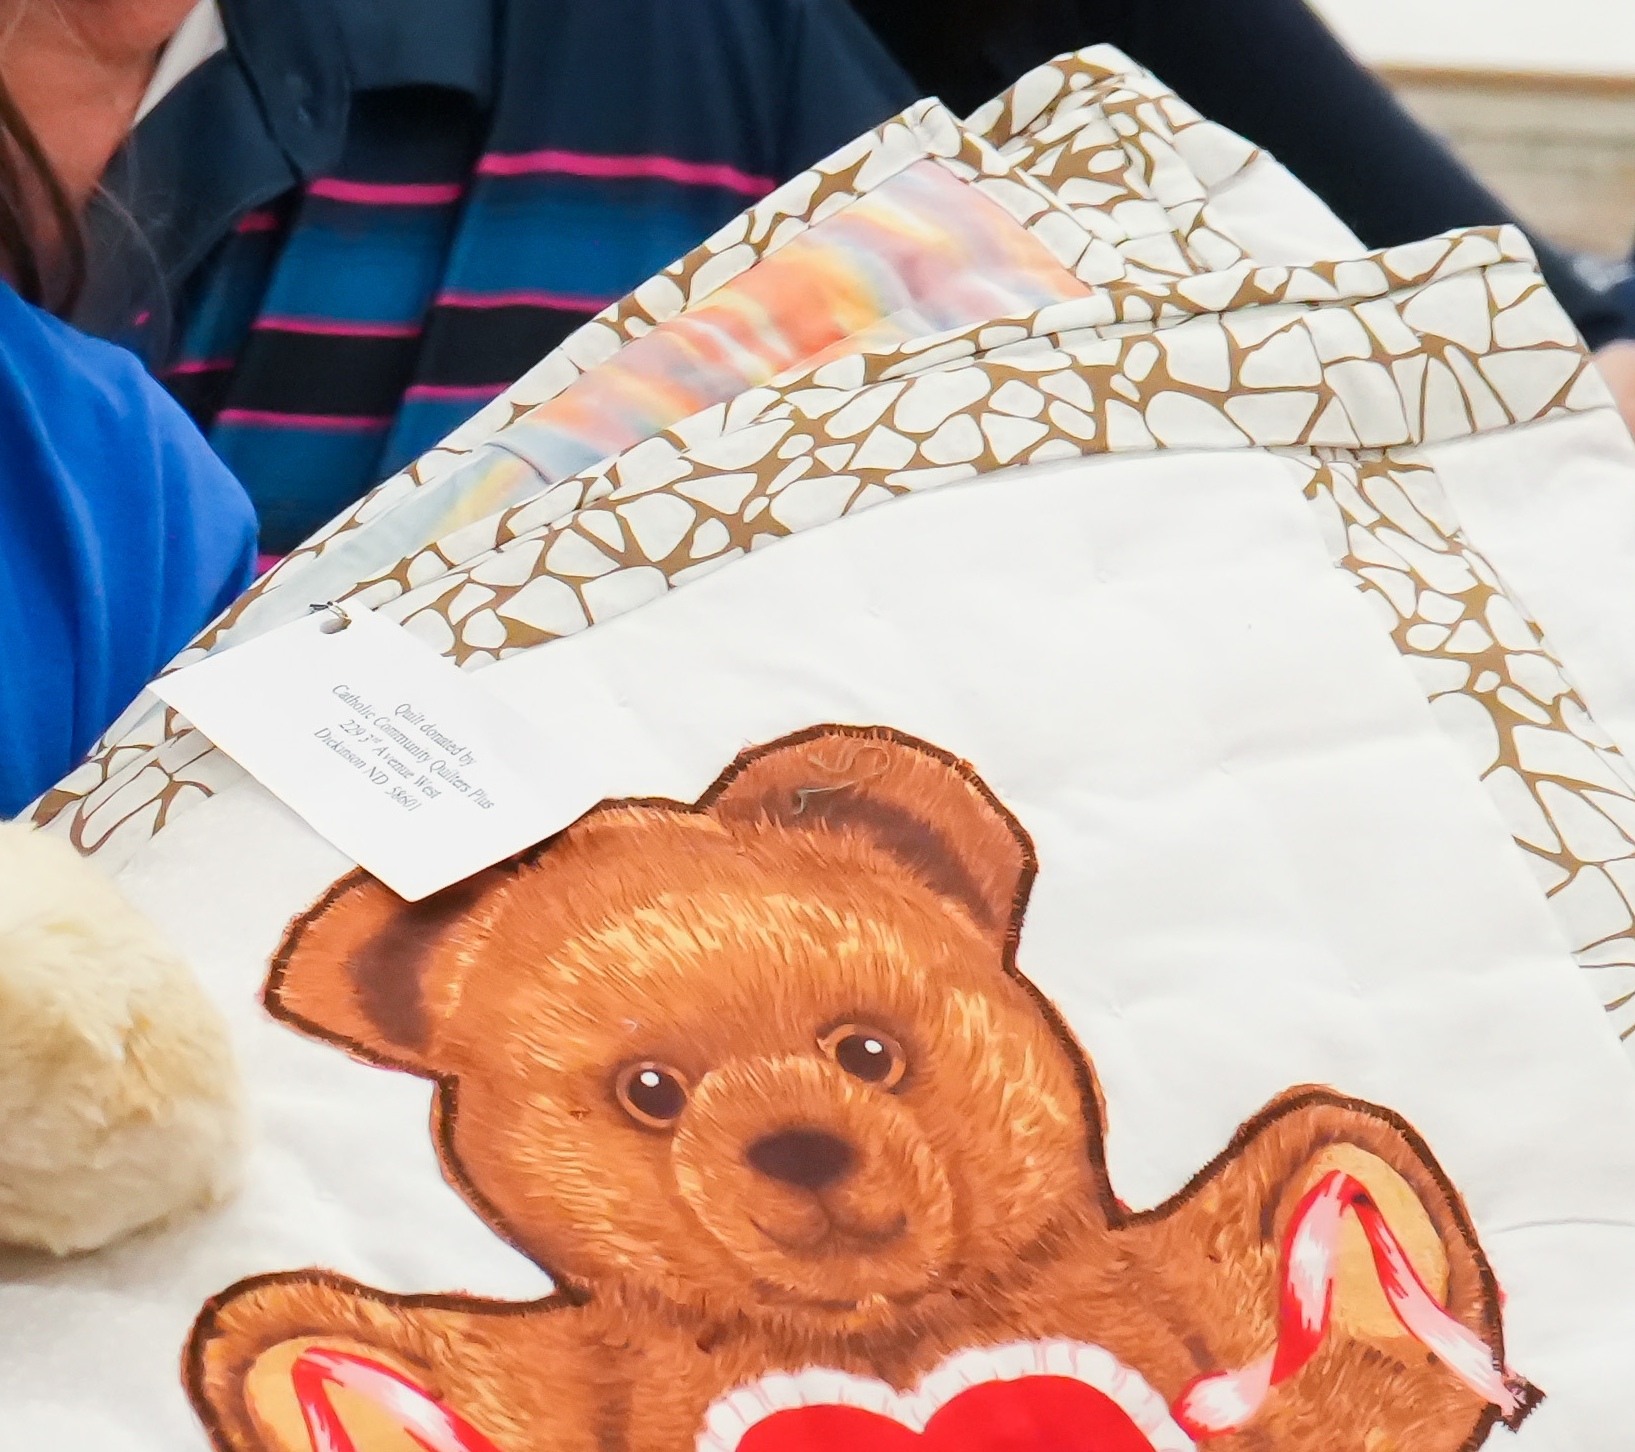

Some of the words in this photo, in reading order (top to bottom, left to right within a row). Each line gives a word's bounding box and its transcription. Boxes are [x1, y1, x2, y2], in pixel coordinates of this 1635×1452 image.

[314, 727, 367, 770] Dickinson
[363, 766, 389, 786] ND
[384, 786, 422, 812] 58601
[332, 684, 376, 720] Catholic
[373, 716, 433, 764] Community
[429, 759, 472, 793] Quilters
[467, 788, 495, 810] Plus
[339, 719, 366, 737] 229
[372, 746, 415, 779] Avenue
[414, 775, 442, 799] West
[394, 703, 425, 726] Quilt
[419, 723, 464, 756] donated
[459, 750, 477, 767] by
